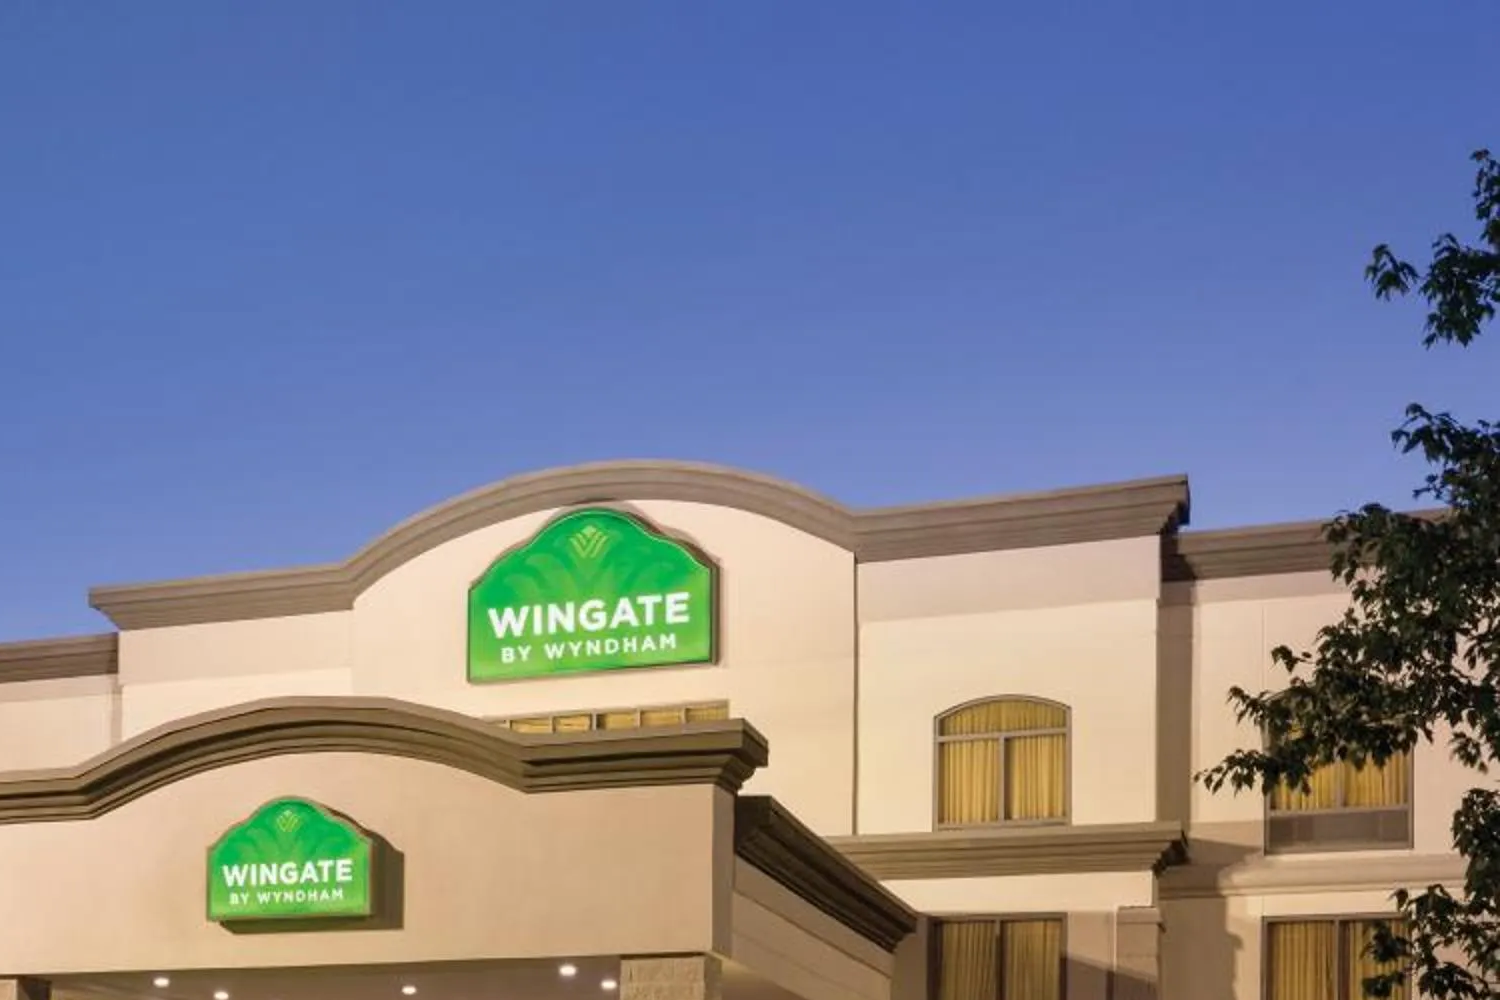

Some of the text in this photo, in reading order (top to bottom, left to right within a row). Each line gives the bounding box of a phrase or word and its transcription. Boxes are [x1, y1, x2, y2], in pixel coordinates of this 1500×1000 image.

[488, 591, 690, 638] WINGATE
[501, 633, 677, 664] BY WYNDHAM
[223, 858, 353, 887] WINGATE
[229, 887, 344, 906] BY WYNDHAM
